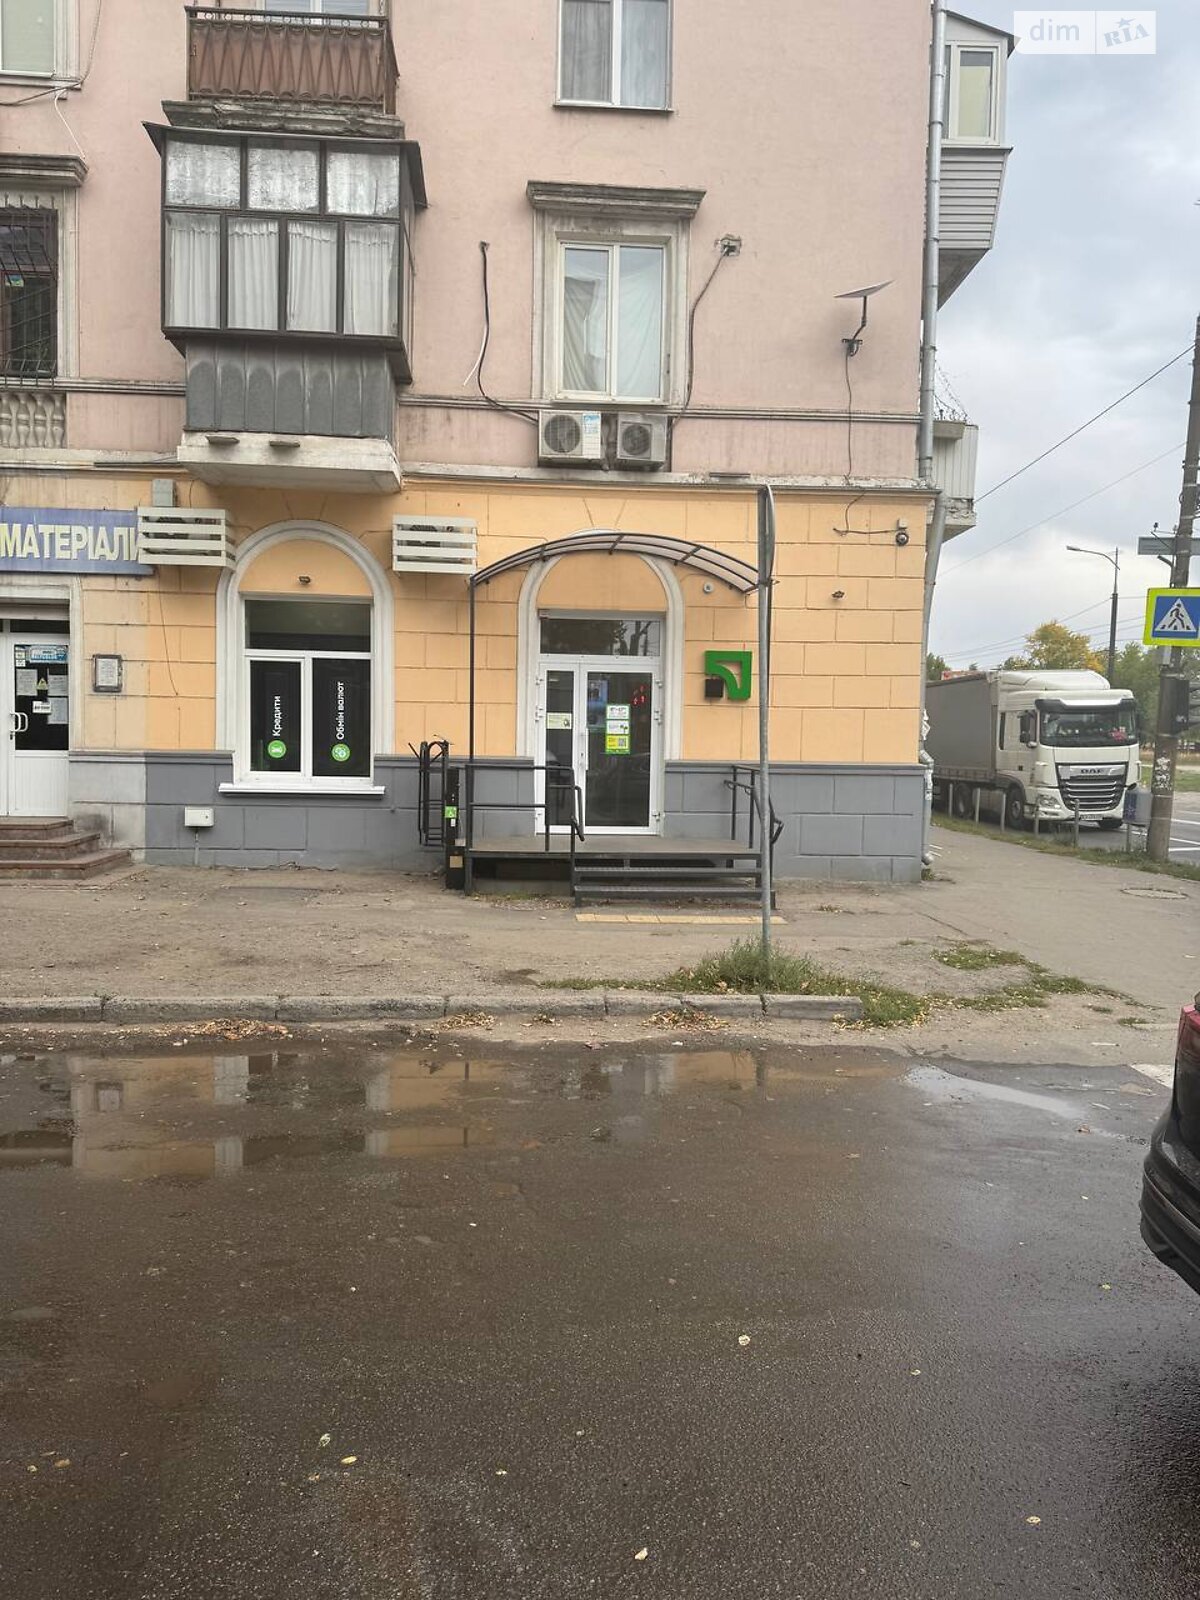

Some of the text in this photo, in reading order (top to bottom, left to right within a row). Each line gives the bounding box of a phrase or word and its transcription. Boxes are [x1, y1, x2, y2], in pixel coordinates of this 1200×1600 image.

[272, 696, 282, 737] Кредити
[335, 681, 345, 740] Обмін валют
